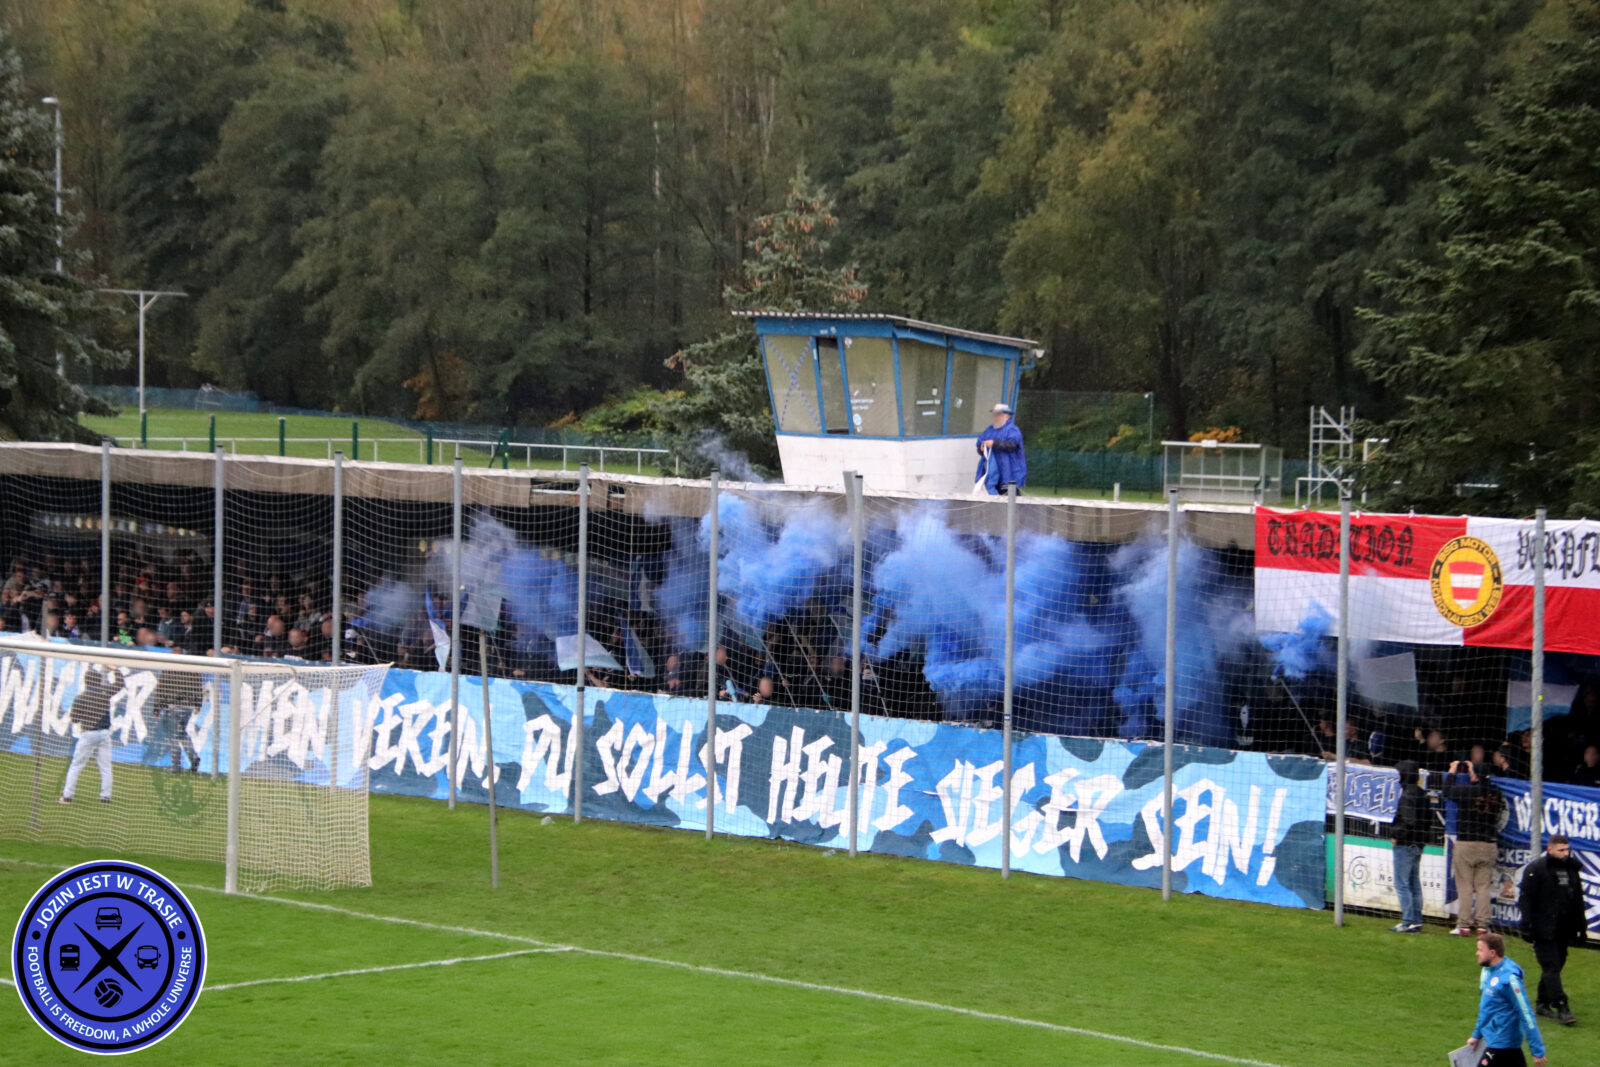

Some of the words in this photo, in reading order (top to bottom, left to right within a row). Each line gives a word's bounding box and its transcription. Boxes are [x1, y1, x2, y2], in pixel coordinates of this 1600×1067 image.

[1460, 537, 1498, 565] MOTOR
[591, 717, 753, 816] SOLLST
[766, 725, 919, 838] HEUTE
